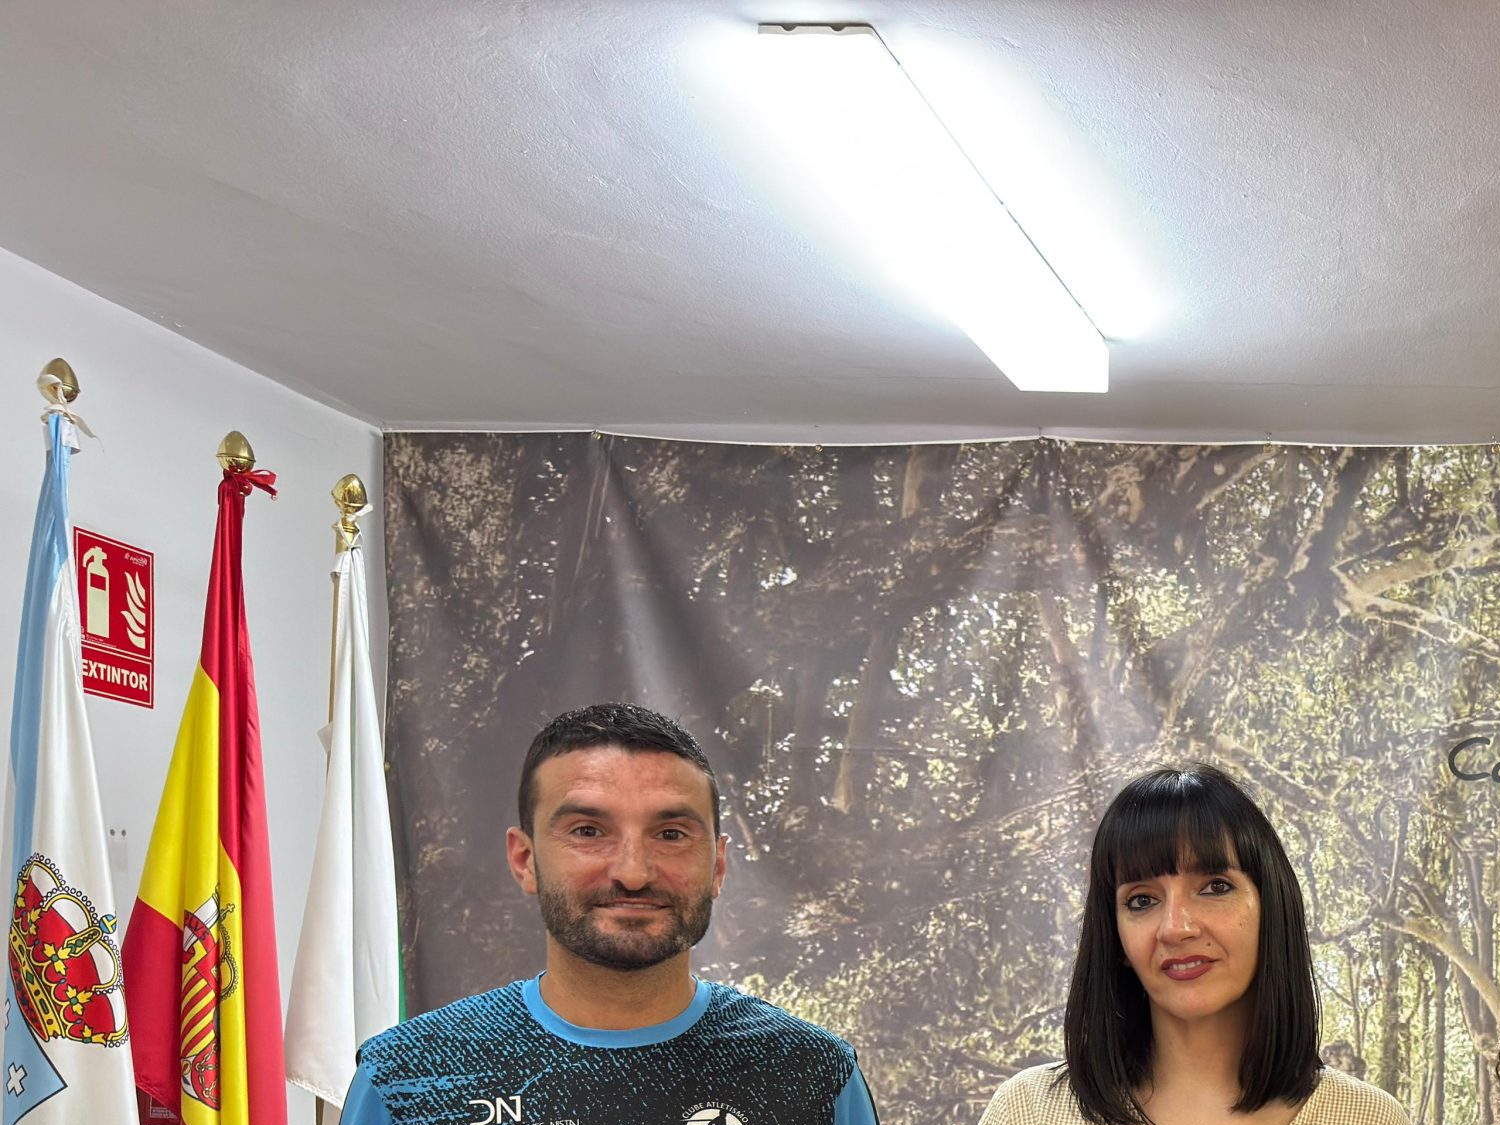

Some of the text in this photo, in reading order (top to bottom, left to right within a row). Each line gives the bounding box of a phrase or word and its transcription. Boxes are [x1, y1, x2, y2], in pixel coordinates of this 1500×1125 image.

[82, 660, 148, 691] EXTINTOR
[682, 1102, 748, 1122] CLUBE ATLETISMO
